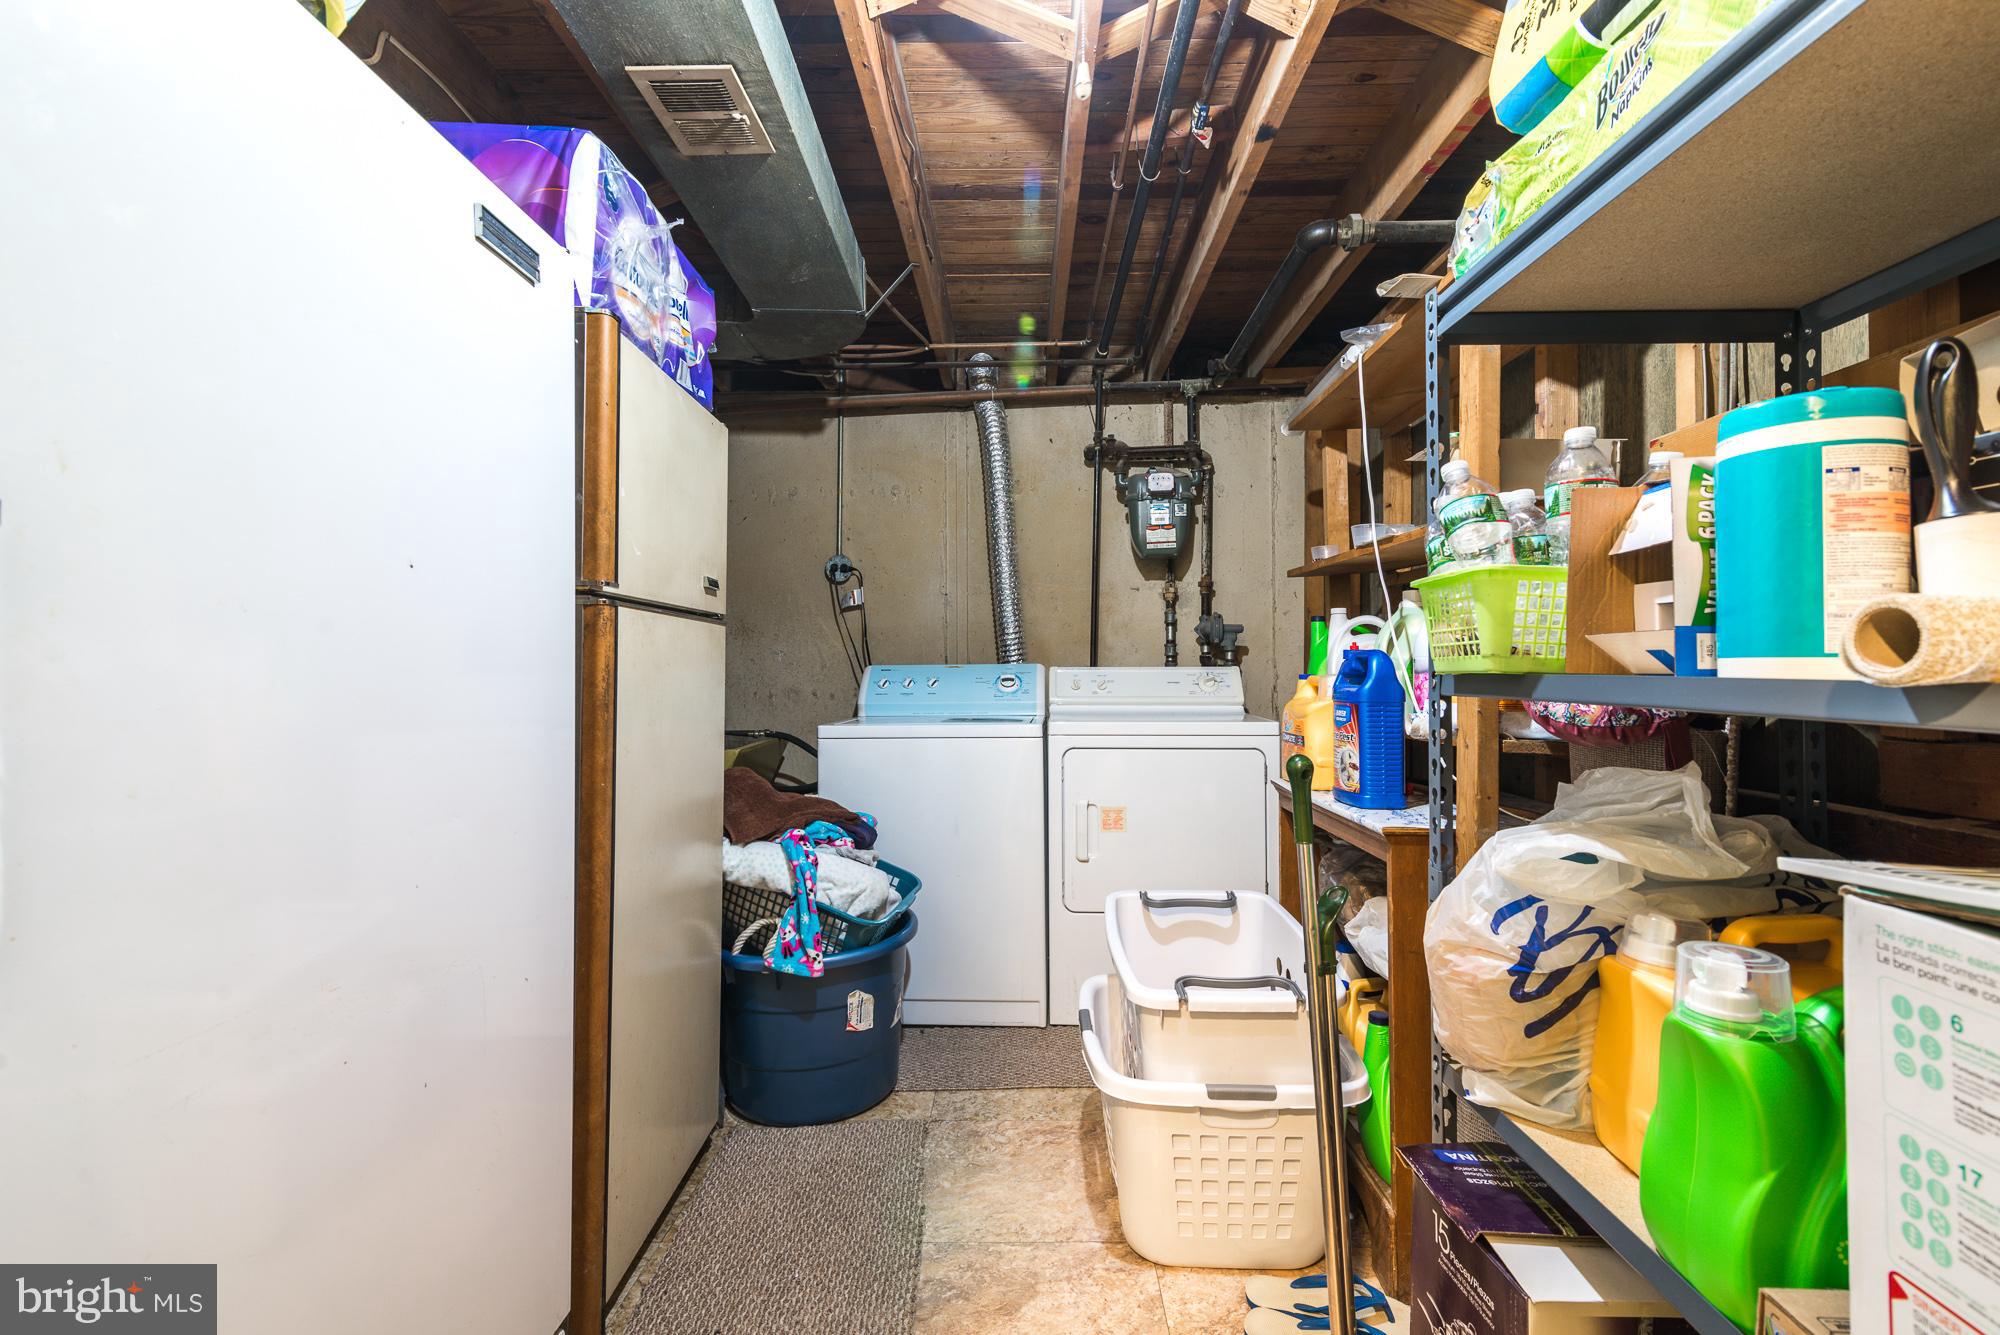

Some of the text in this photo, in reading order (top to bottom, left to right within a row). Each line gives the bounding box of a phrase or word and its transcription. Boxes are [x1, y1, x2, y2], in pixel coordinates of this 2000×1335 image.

[1610, 56, 1654, 129] Napkins
[1698, 472, 1716, 523] PACK
[1698, 526, 1716, 540] 6
[1876, 924, 1896, 941] The
[1899, 934, 1924, 949] right
[1876, 938, 1890, 952] La
[1892, 946, 1940, 969] puntada
[1877, 951, 1890, 966] Le
[1892, 957, 1915, 974] bon
[1954, 982, 1979, 998] une
[1950, 1014, 1964, 1033] 6
[1958, 1163, 1983, 1189] 17
[1432, 1209, 1450, 1254] 15
